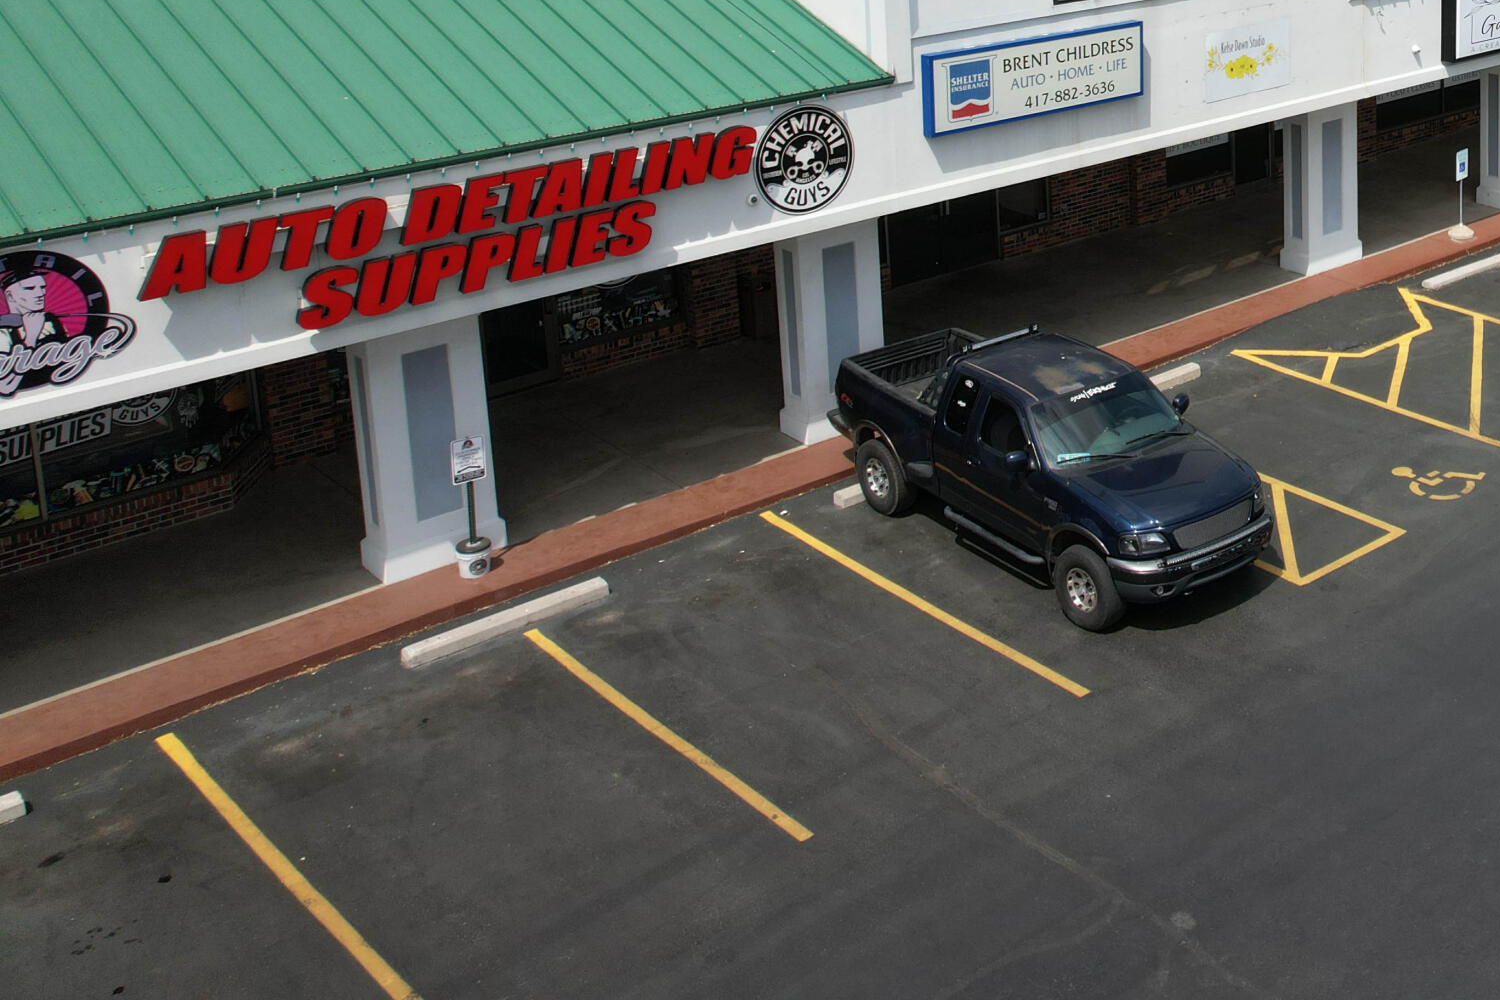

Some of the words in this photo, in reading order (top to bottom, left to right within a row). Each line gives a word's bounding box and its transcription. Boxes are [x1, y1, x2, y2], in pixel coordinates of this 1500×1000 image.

[1003, 51, 1051, 73] BRENT
[1056, 37, 1134, 63] CHILDRESS
[951, 72, 989, 87] SHELTER
[951, 81, 989, 93] INSURANCE
[1010, 73, 1046, 90] AUTO
[1057, 64, 1094, 81] HOME
[1106, 58, 1128, 72] LIFE
[1025, 80, 1115, 109] 417-882-3636
[762, 113, 846, 168] CHEMICAL
[784, 181, 831, 206] GUYS
[138, 196, 388, 302] AUTO
[401, 125, 756, 246] DETAILING
[296, 200, 657, 331] SUPPLIES
[119, 401, 162, 419] GUYS
